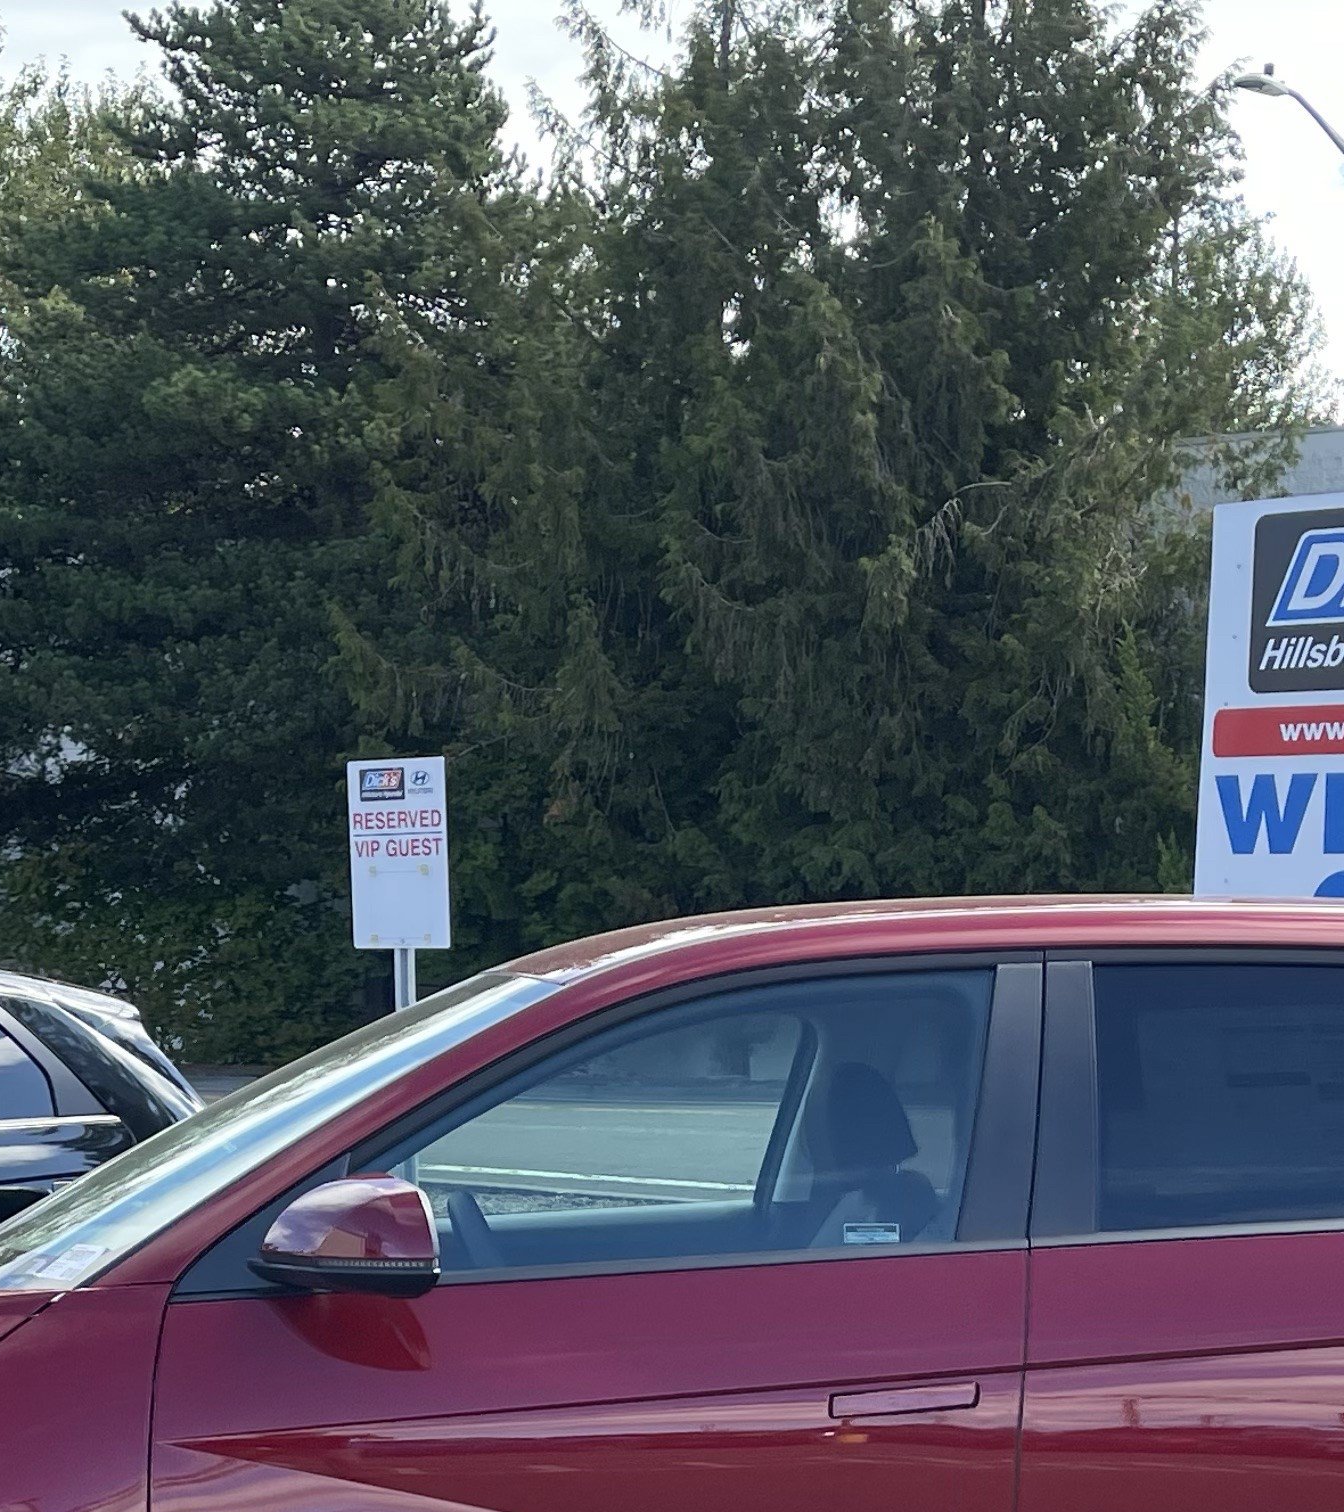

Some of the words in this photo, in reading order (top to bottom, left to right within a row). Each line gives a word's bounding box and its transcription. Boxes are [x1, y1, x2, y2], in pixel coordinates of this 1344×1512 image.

[352, 809, 442, 830] RESERVED
[354, 840, 381, 858] VIP
[385, 838, 443, 857] GUEST
